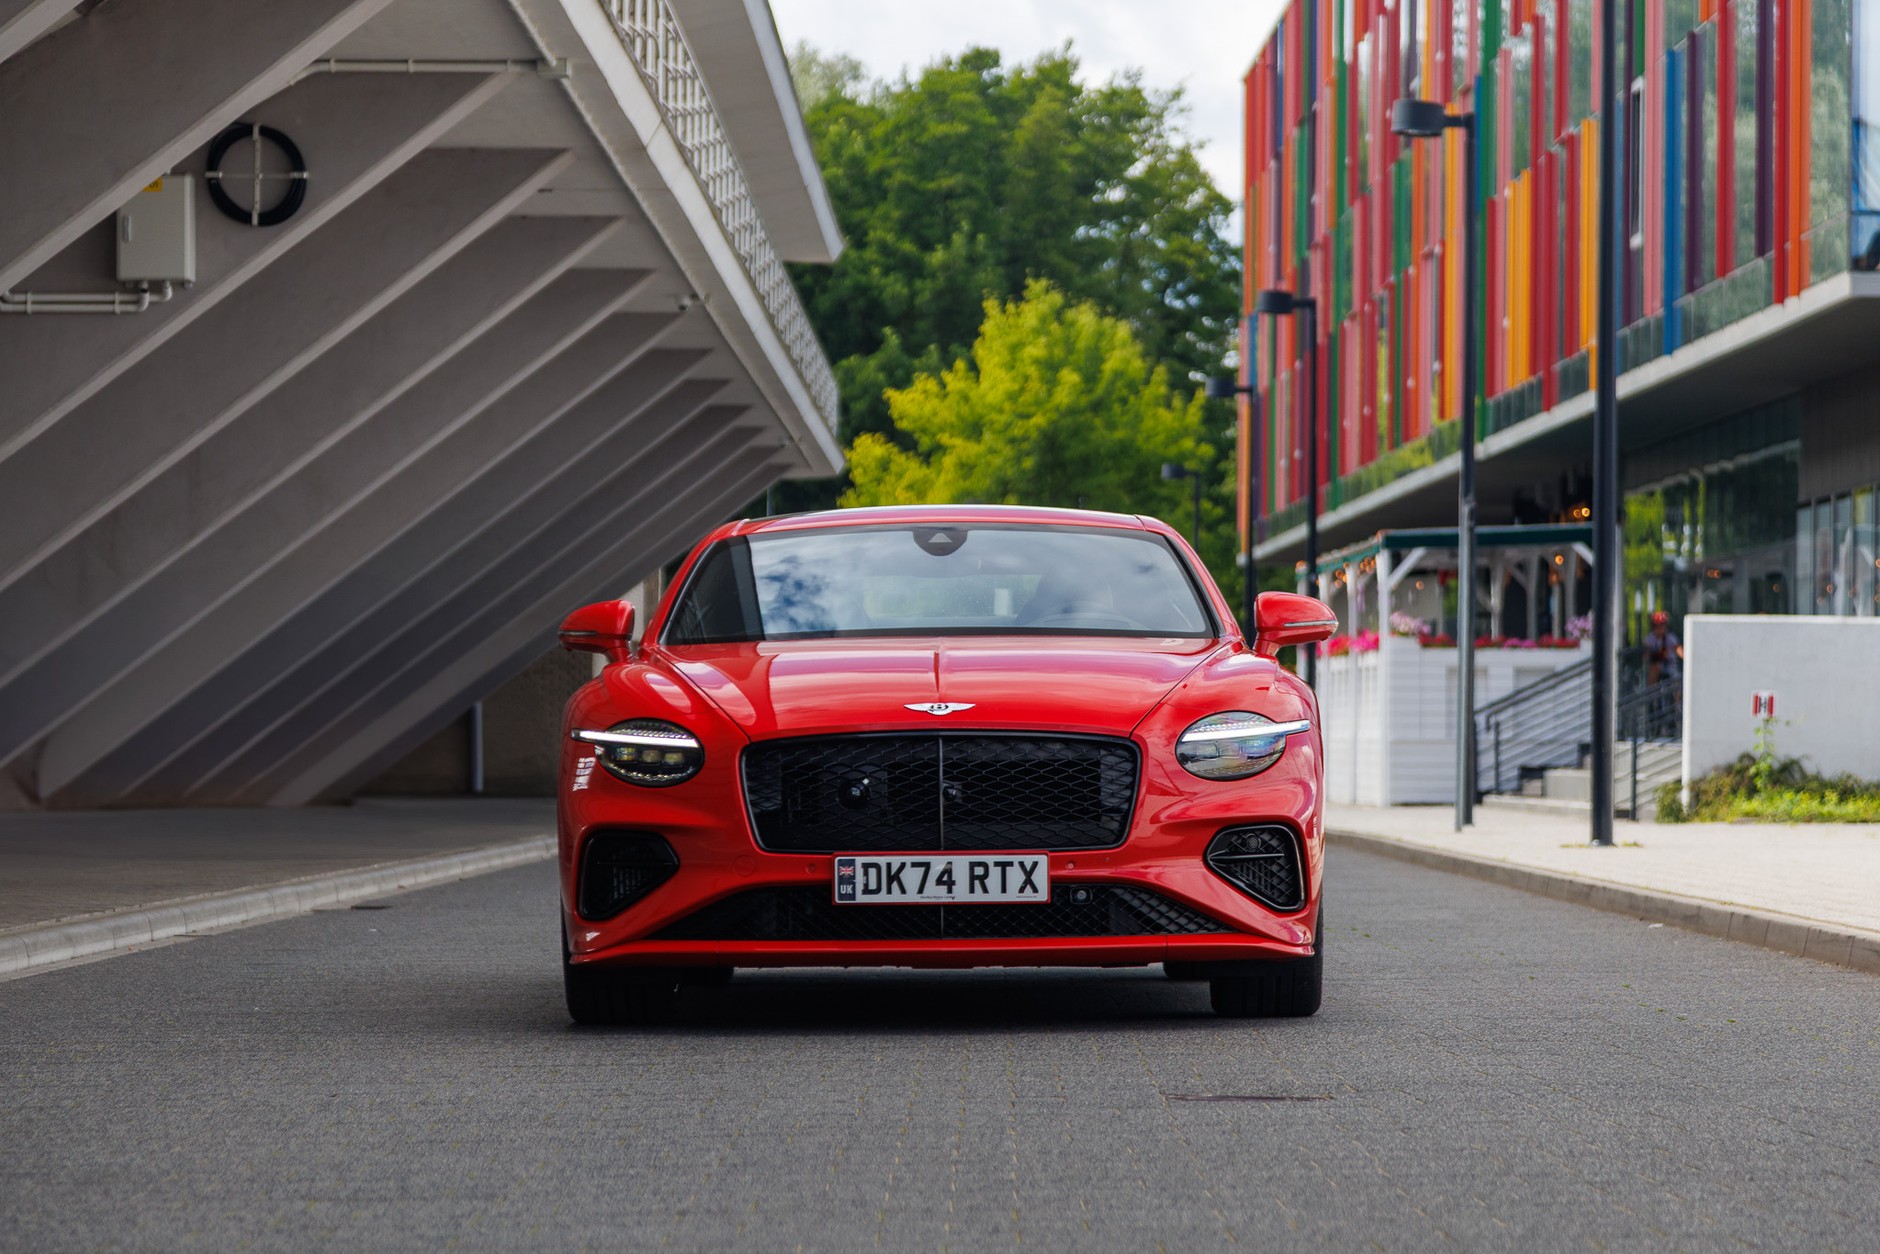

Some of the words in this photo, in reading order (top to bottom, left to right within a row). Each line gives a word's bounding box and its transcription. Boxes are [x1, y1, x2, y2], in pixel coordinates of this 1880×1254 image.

[861, 861, 956, 895] DK74
[968, 860, 1039, 894] RTX
[840, 884, 853, 894] UK
